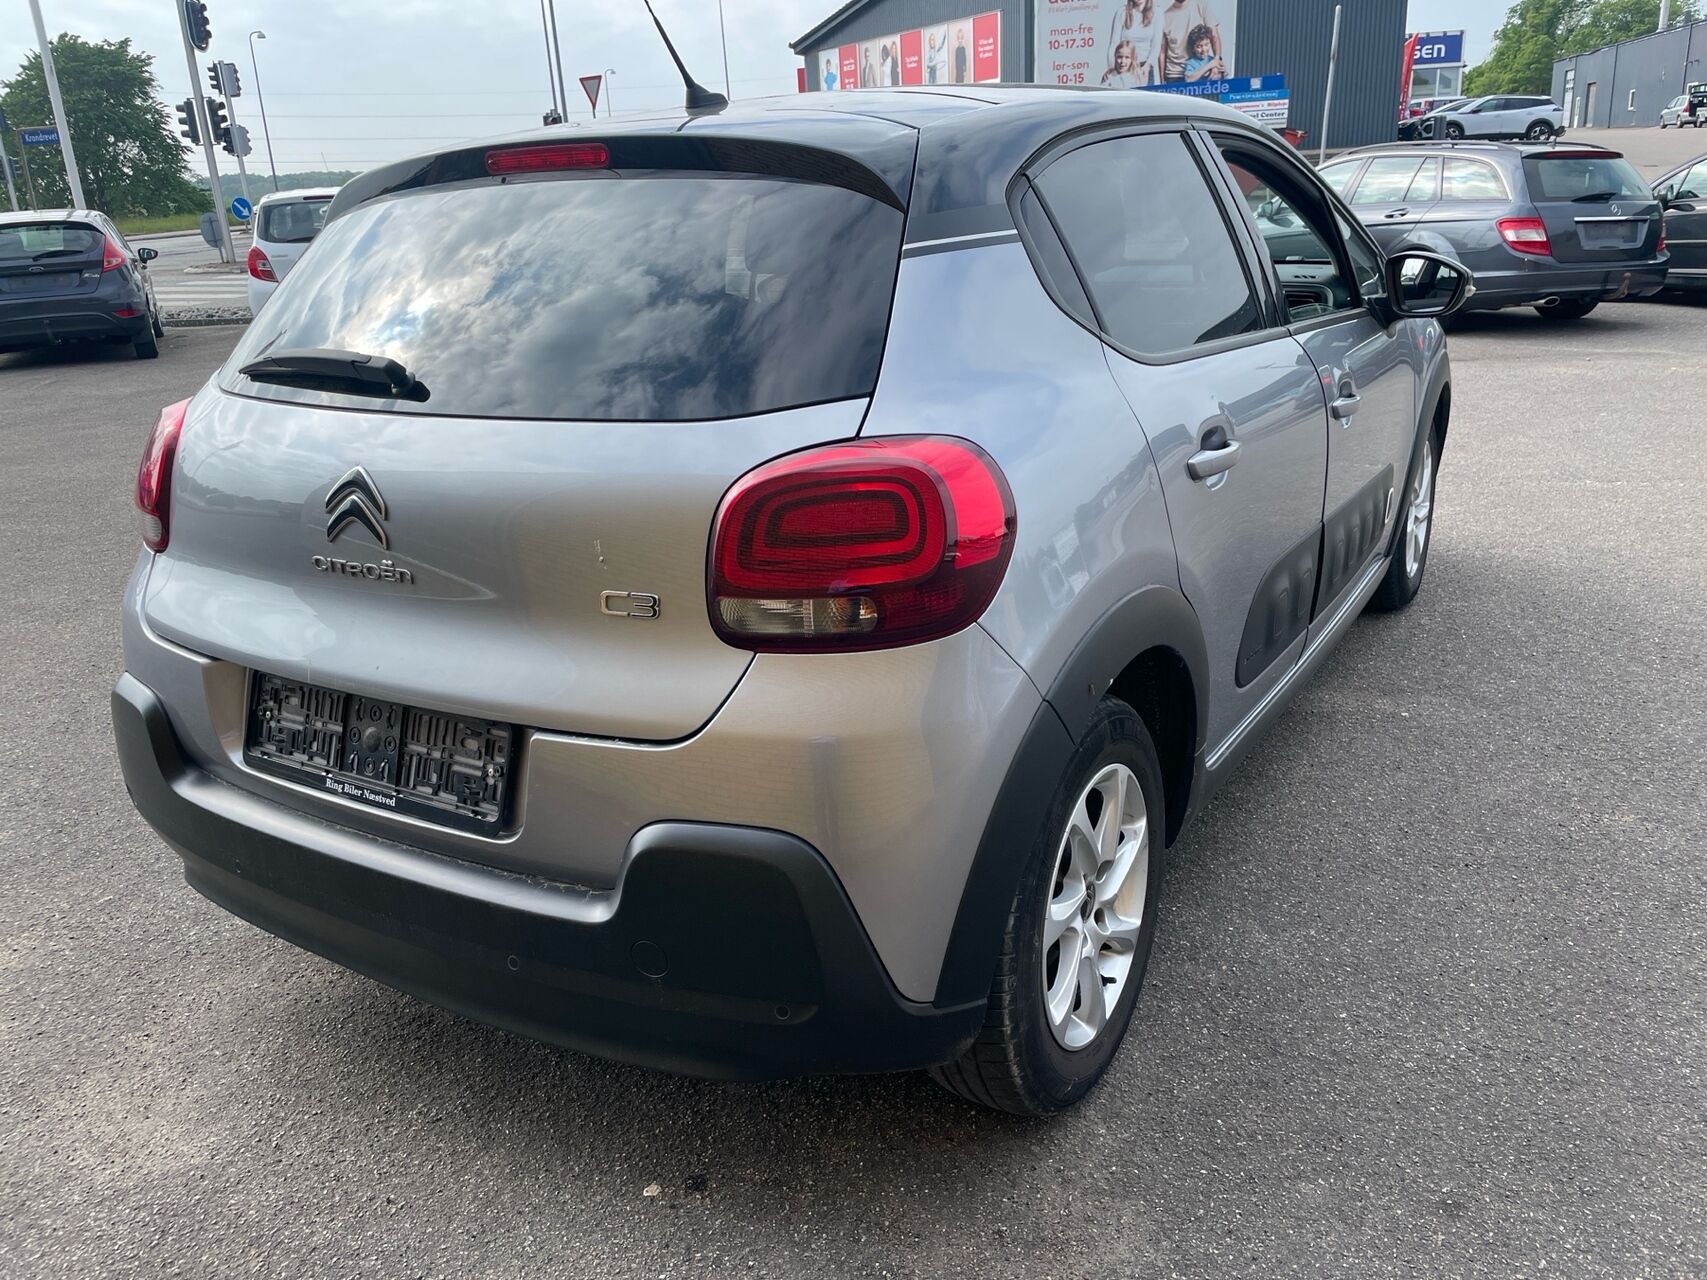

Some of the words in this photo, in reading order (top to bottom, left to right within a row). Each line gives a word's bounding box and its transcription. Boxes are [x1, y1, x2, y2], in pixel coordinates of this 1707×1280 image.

[1050, 24, 1094, 36] man-fre
[1048, 37, 1095, 50] 10-17.30
[1057, 73, 1085, 84] 10-15
[600, 590, 660, 619] C3
[325, 778, 343, 792] Ring
[344, 783, 362, 797] Biler
[363, 789, 396, 807] Næstved
